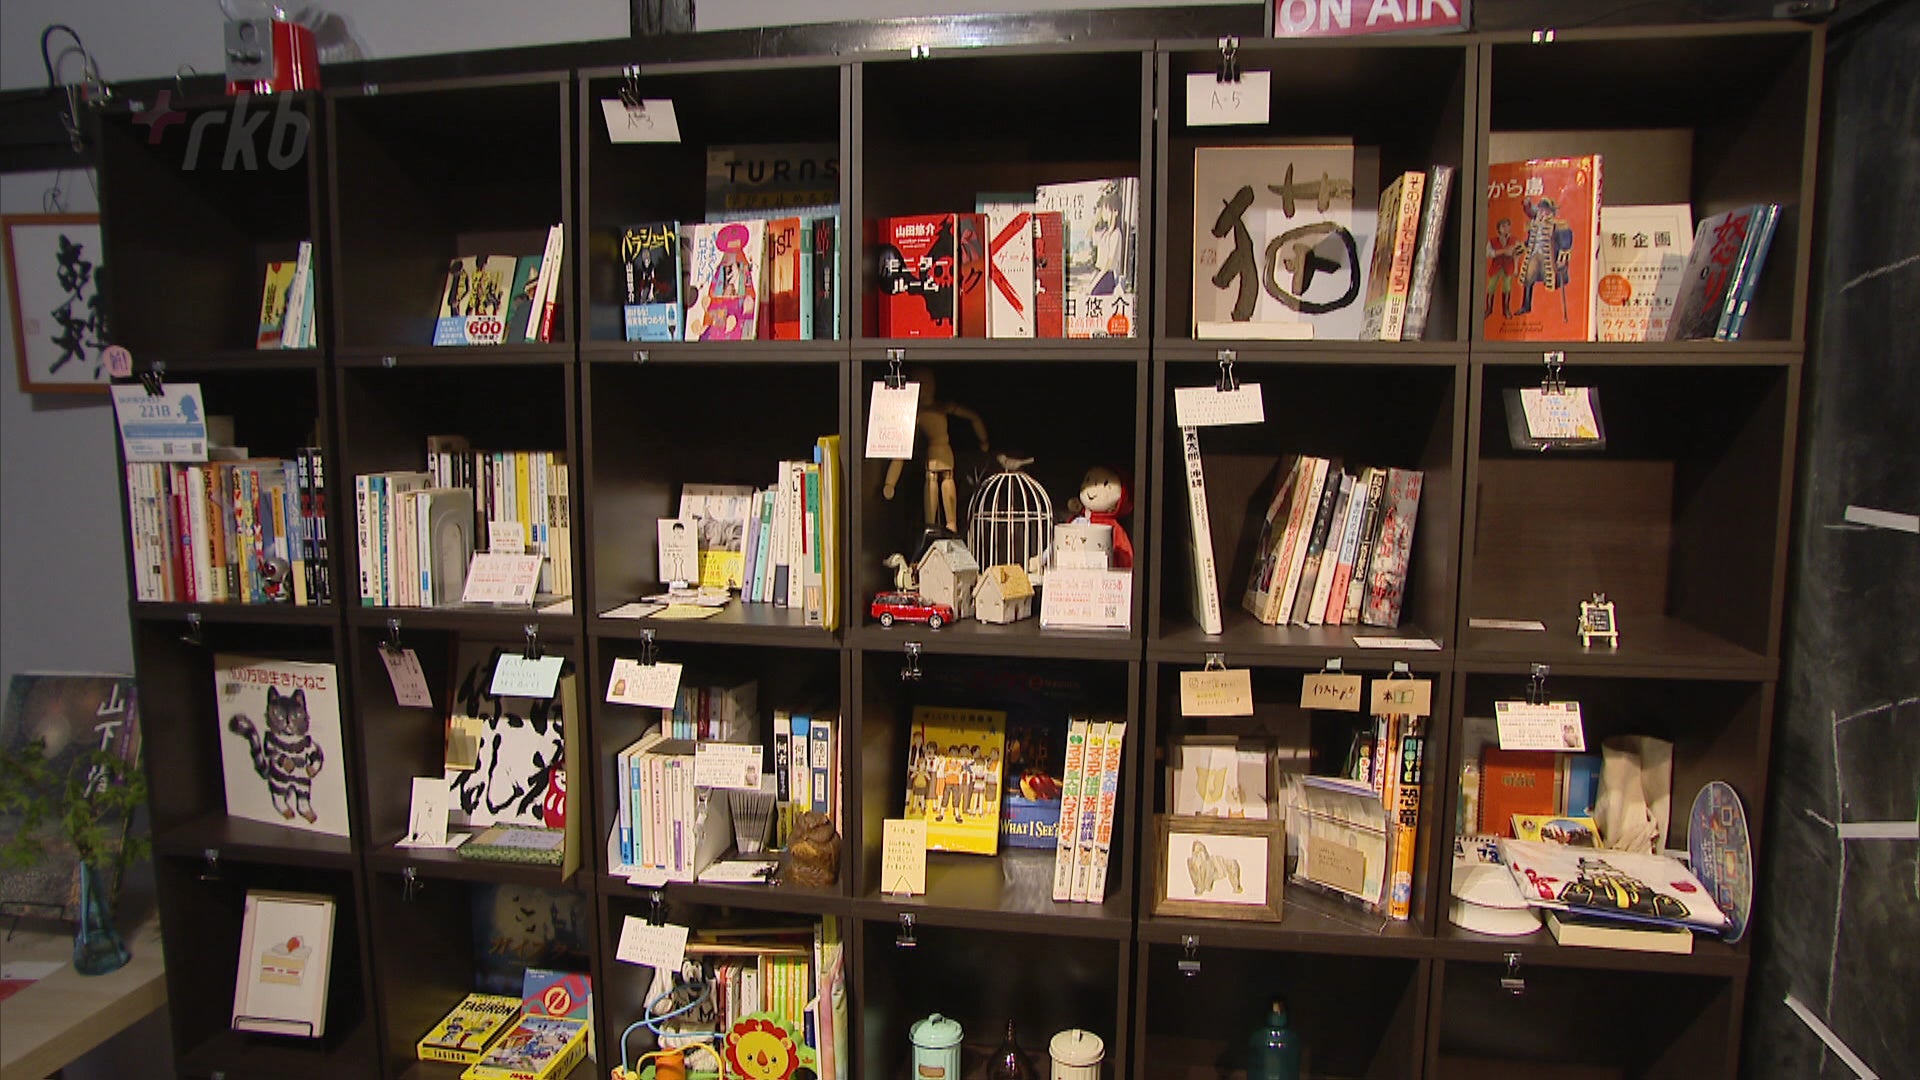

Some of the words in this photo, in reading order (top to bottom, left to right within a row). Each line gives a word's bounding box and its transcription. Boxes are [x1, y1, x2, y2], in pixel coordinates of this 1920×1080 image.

[1280, 0, 1351, 32] ON
[895, 224, 935, 238] 山田悠介
[1611, 231, 1671, 248] 新企画
[888, 255, 949, 275] モニター
[892, 277, 940, 294] ルーム
[469, 320, 502, 335] 600
[139, 405, 171, 418] 221B
[1399, 788, 1418, 827] 恐竜
[1001, 819, 1028, 835] WHAT
[1029, 821, 1035, 837] I
